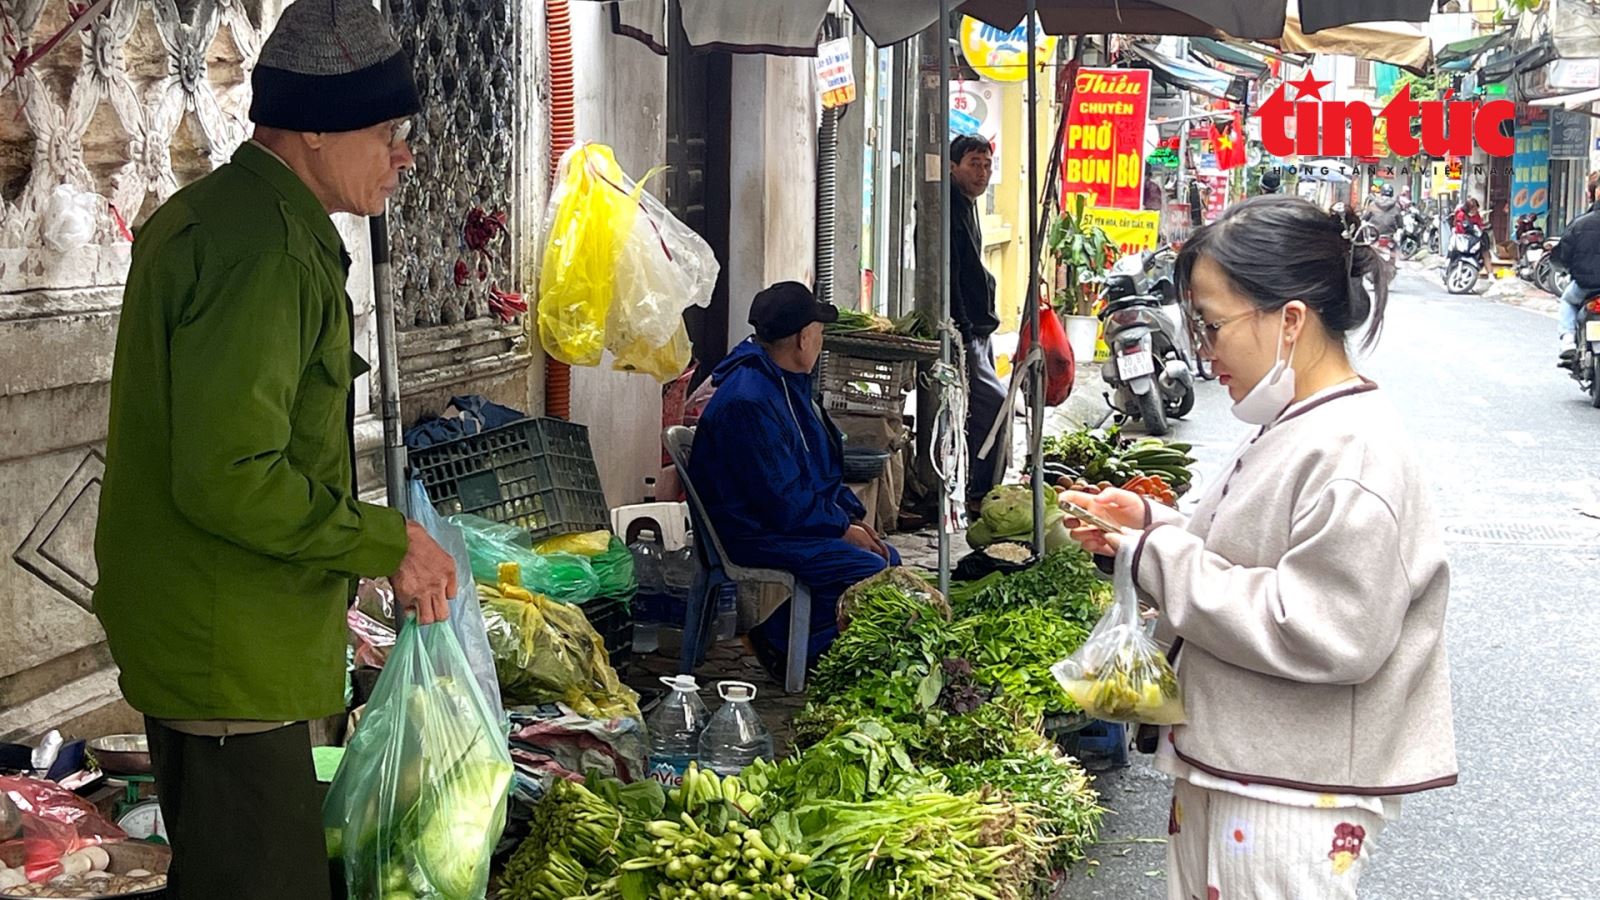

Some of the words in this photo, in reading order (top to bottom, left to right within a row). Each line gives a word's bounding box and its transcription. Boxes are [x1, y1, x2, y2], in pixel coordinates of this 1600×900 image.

[954, 97, 967, 110] 35
[1079, 101, 1134, 115] CHUYÊN
[1068, 119, 1112, 151] PHỞ
[1066, 155, 1111, 184] BÚN
[1116, 148, 1140, 189] BÒ
